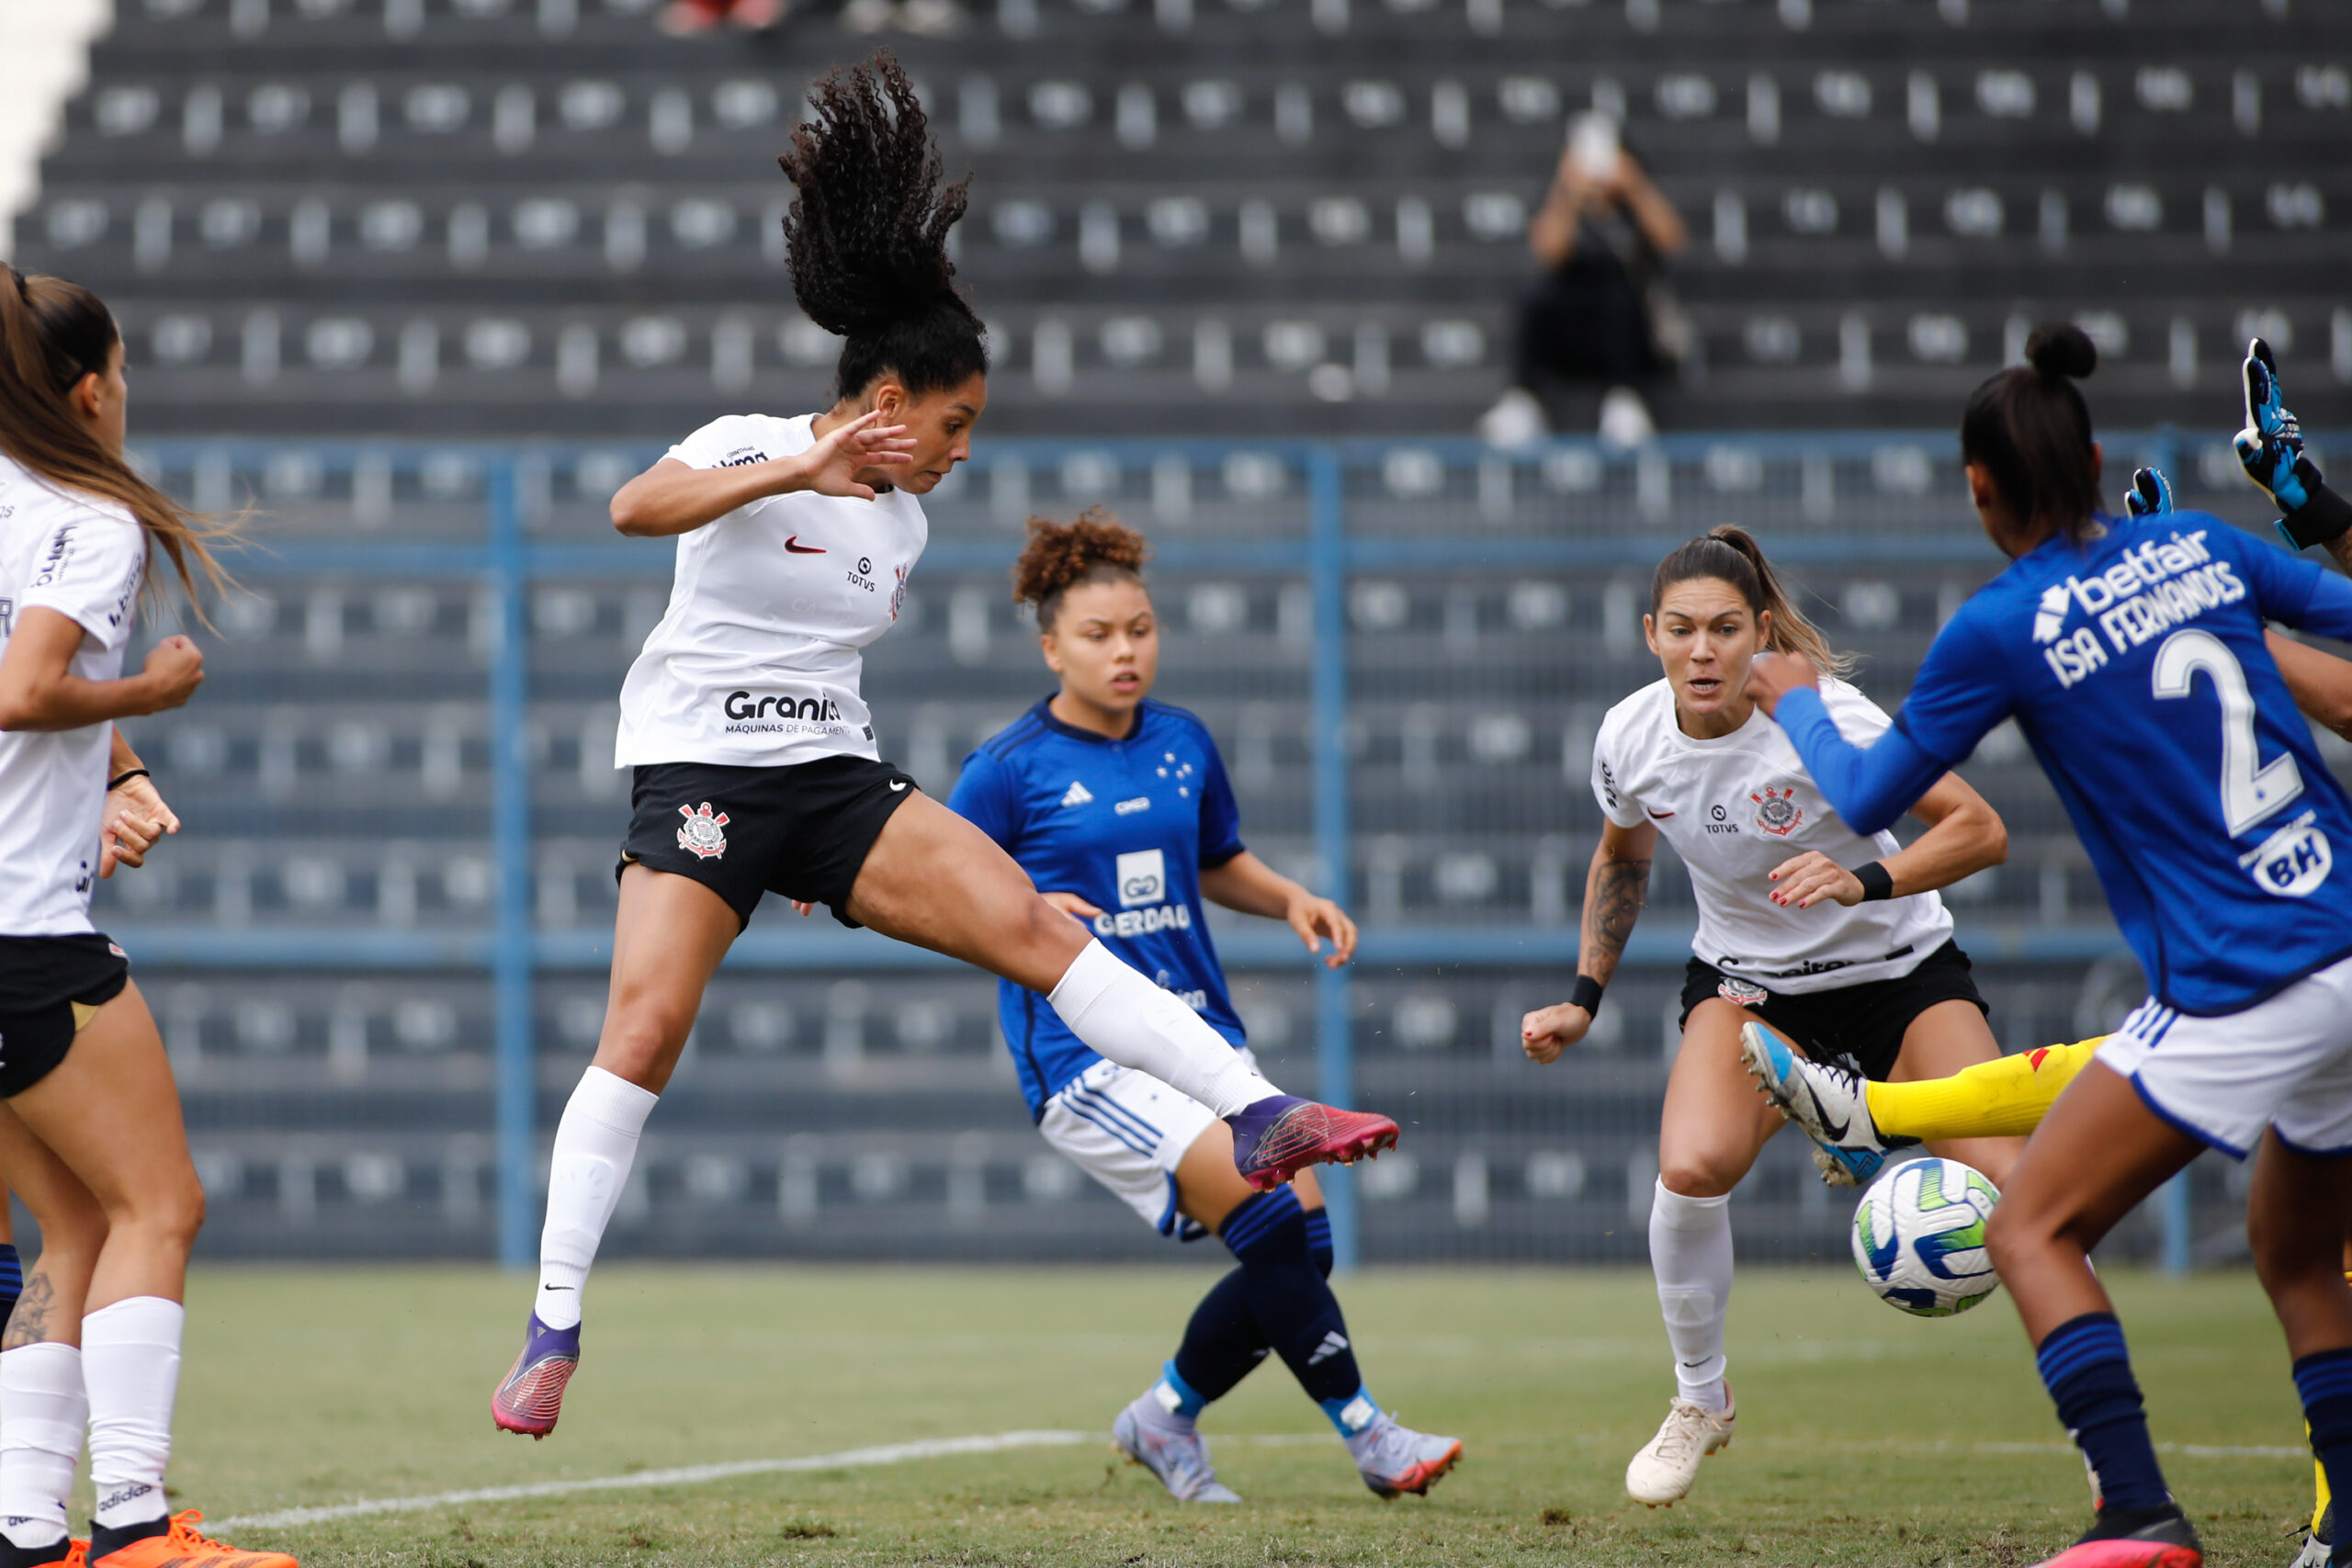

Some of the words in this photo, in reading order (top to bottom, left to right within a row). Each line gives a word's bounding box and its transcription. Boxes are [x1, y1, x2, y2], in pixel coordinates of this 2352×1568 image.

[847, 570, 876, 592] TOTVS
[2064, 530, 2211, 616] betfair
[2043, 627, 2109, 689] ISA
[2098, 560, 2245, 656] FERNANDES
[725, 723, 784, 735] MÁQUINAS
[786, 723, 799, 734] DE
[2152, 628, 2304, 840] 2
[1704, 823, 1739, 834] TOTVS
[2266, 833, 2324, 888] BH
[1093, 904, 1192, 938] GERDAU
[97, 1483, 153, 1513] adidas
